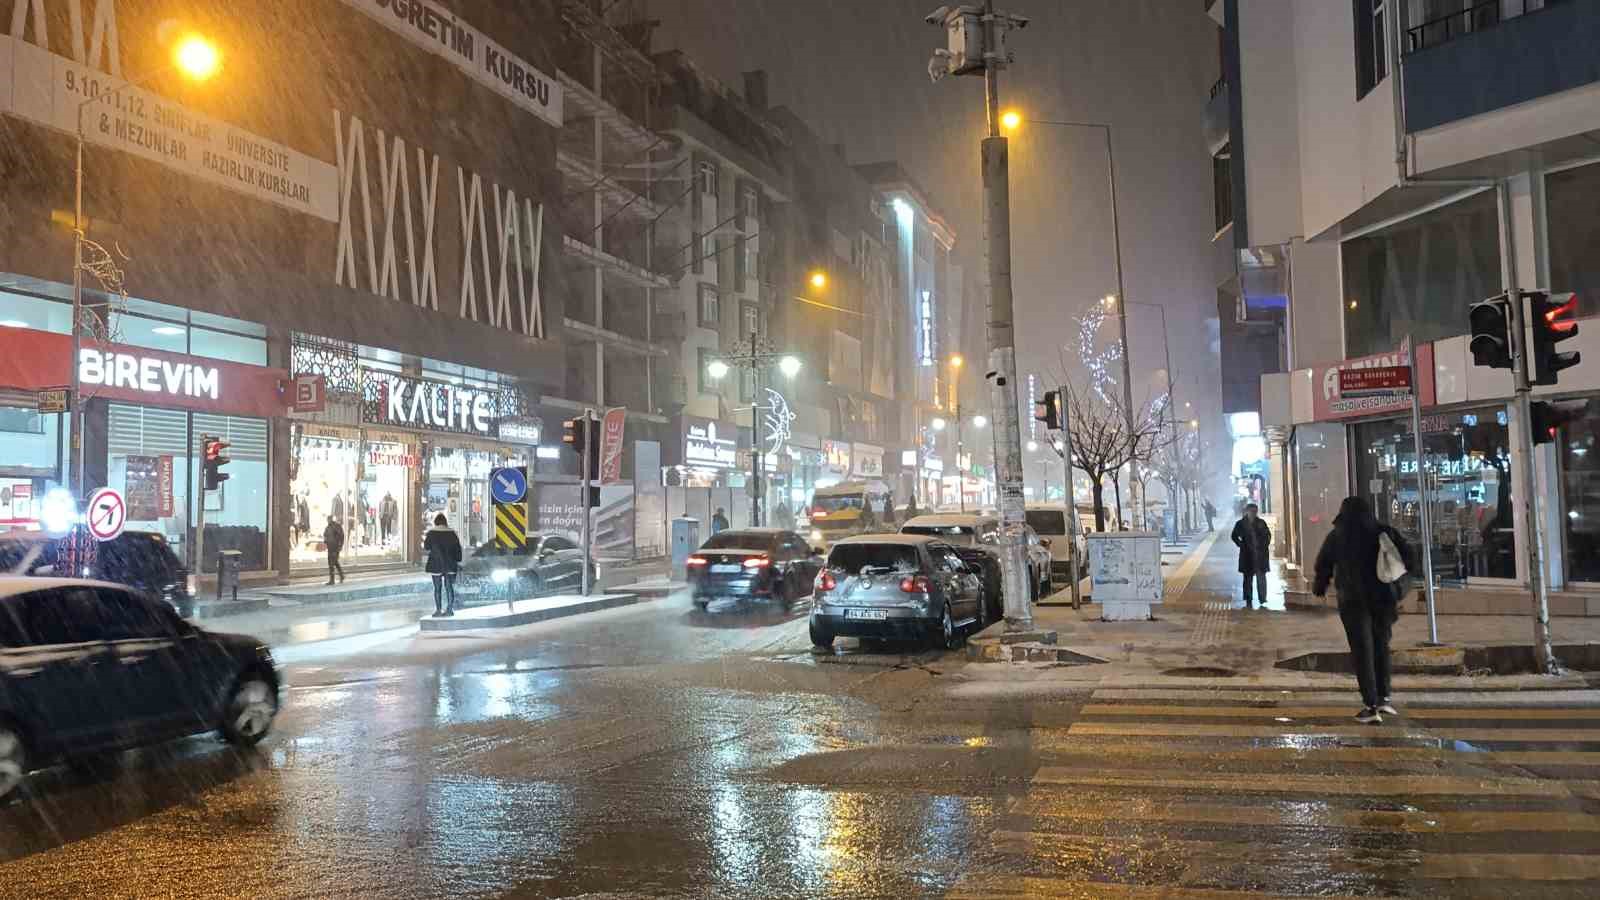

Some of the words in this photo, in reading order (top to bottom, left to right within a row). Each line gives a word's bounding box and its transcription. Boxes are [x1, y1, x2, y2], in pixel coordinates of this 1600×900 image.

[485, 45, 550, 106] KURSU
[98, 112, 111, 132] &
[115, 118, 188, 162] MEZUNLAR
[201, 150, 256, 185] HAZIRLIK
